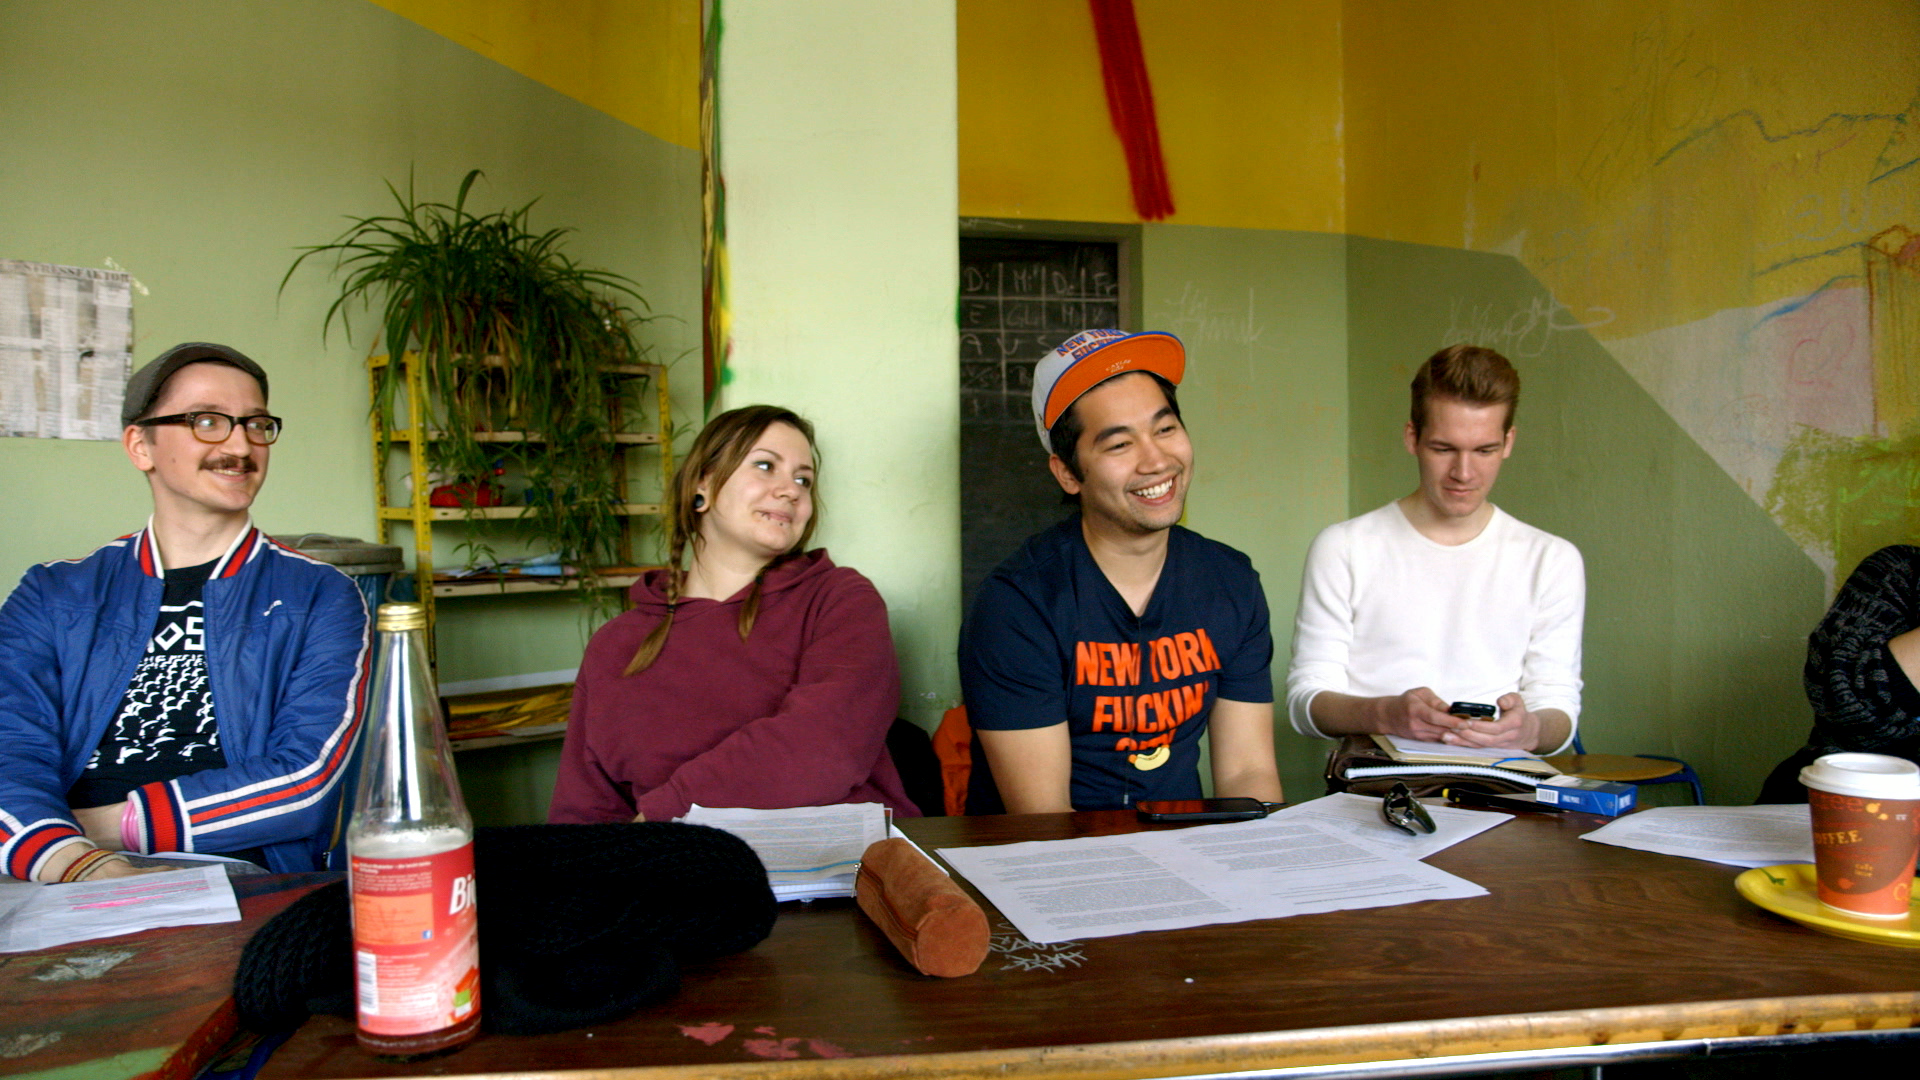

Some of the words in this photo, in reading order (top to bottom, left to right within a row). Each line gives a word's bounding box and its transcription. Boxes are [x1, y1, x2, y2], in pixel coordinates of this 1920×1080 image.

[1056, 335, 1087, 358] NEW
[1075, 641, 1142, 686] NEW
[1149, 628, 1222, 683] YORK
[1092, 680, 1210, 734] FUCKIN'
[1814, 830, 1862, 844] OFFEE
